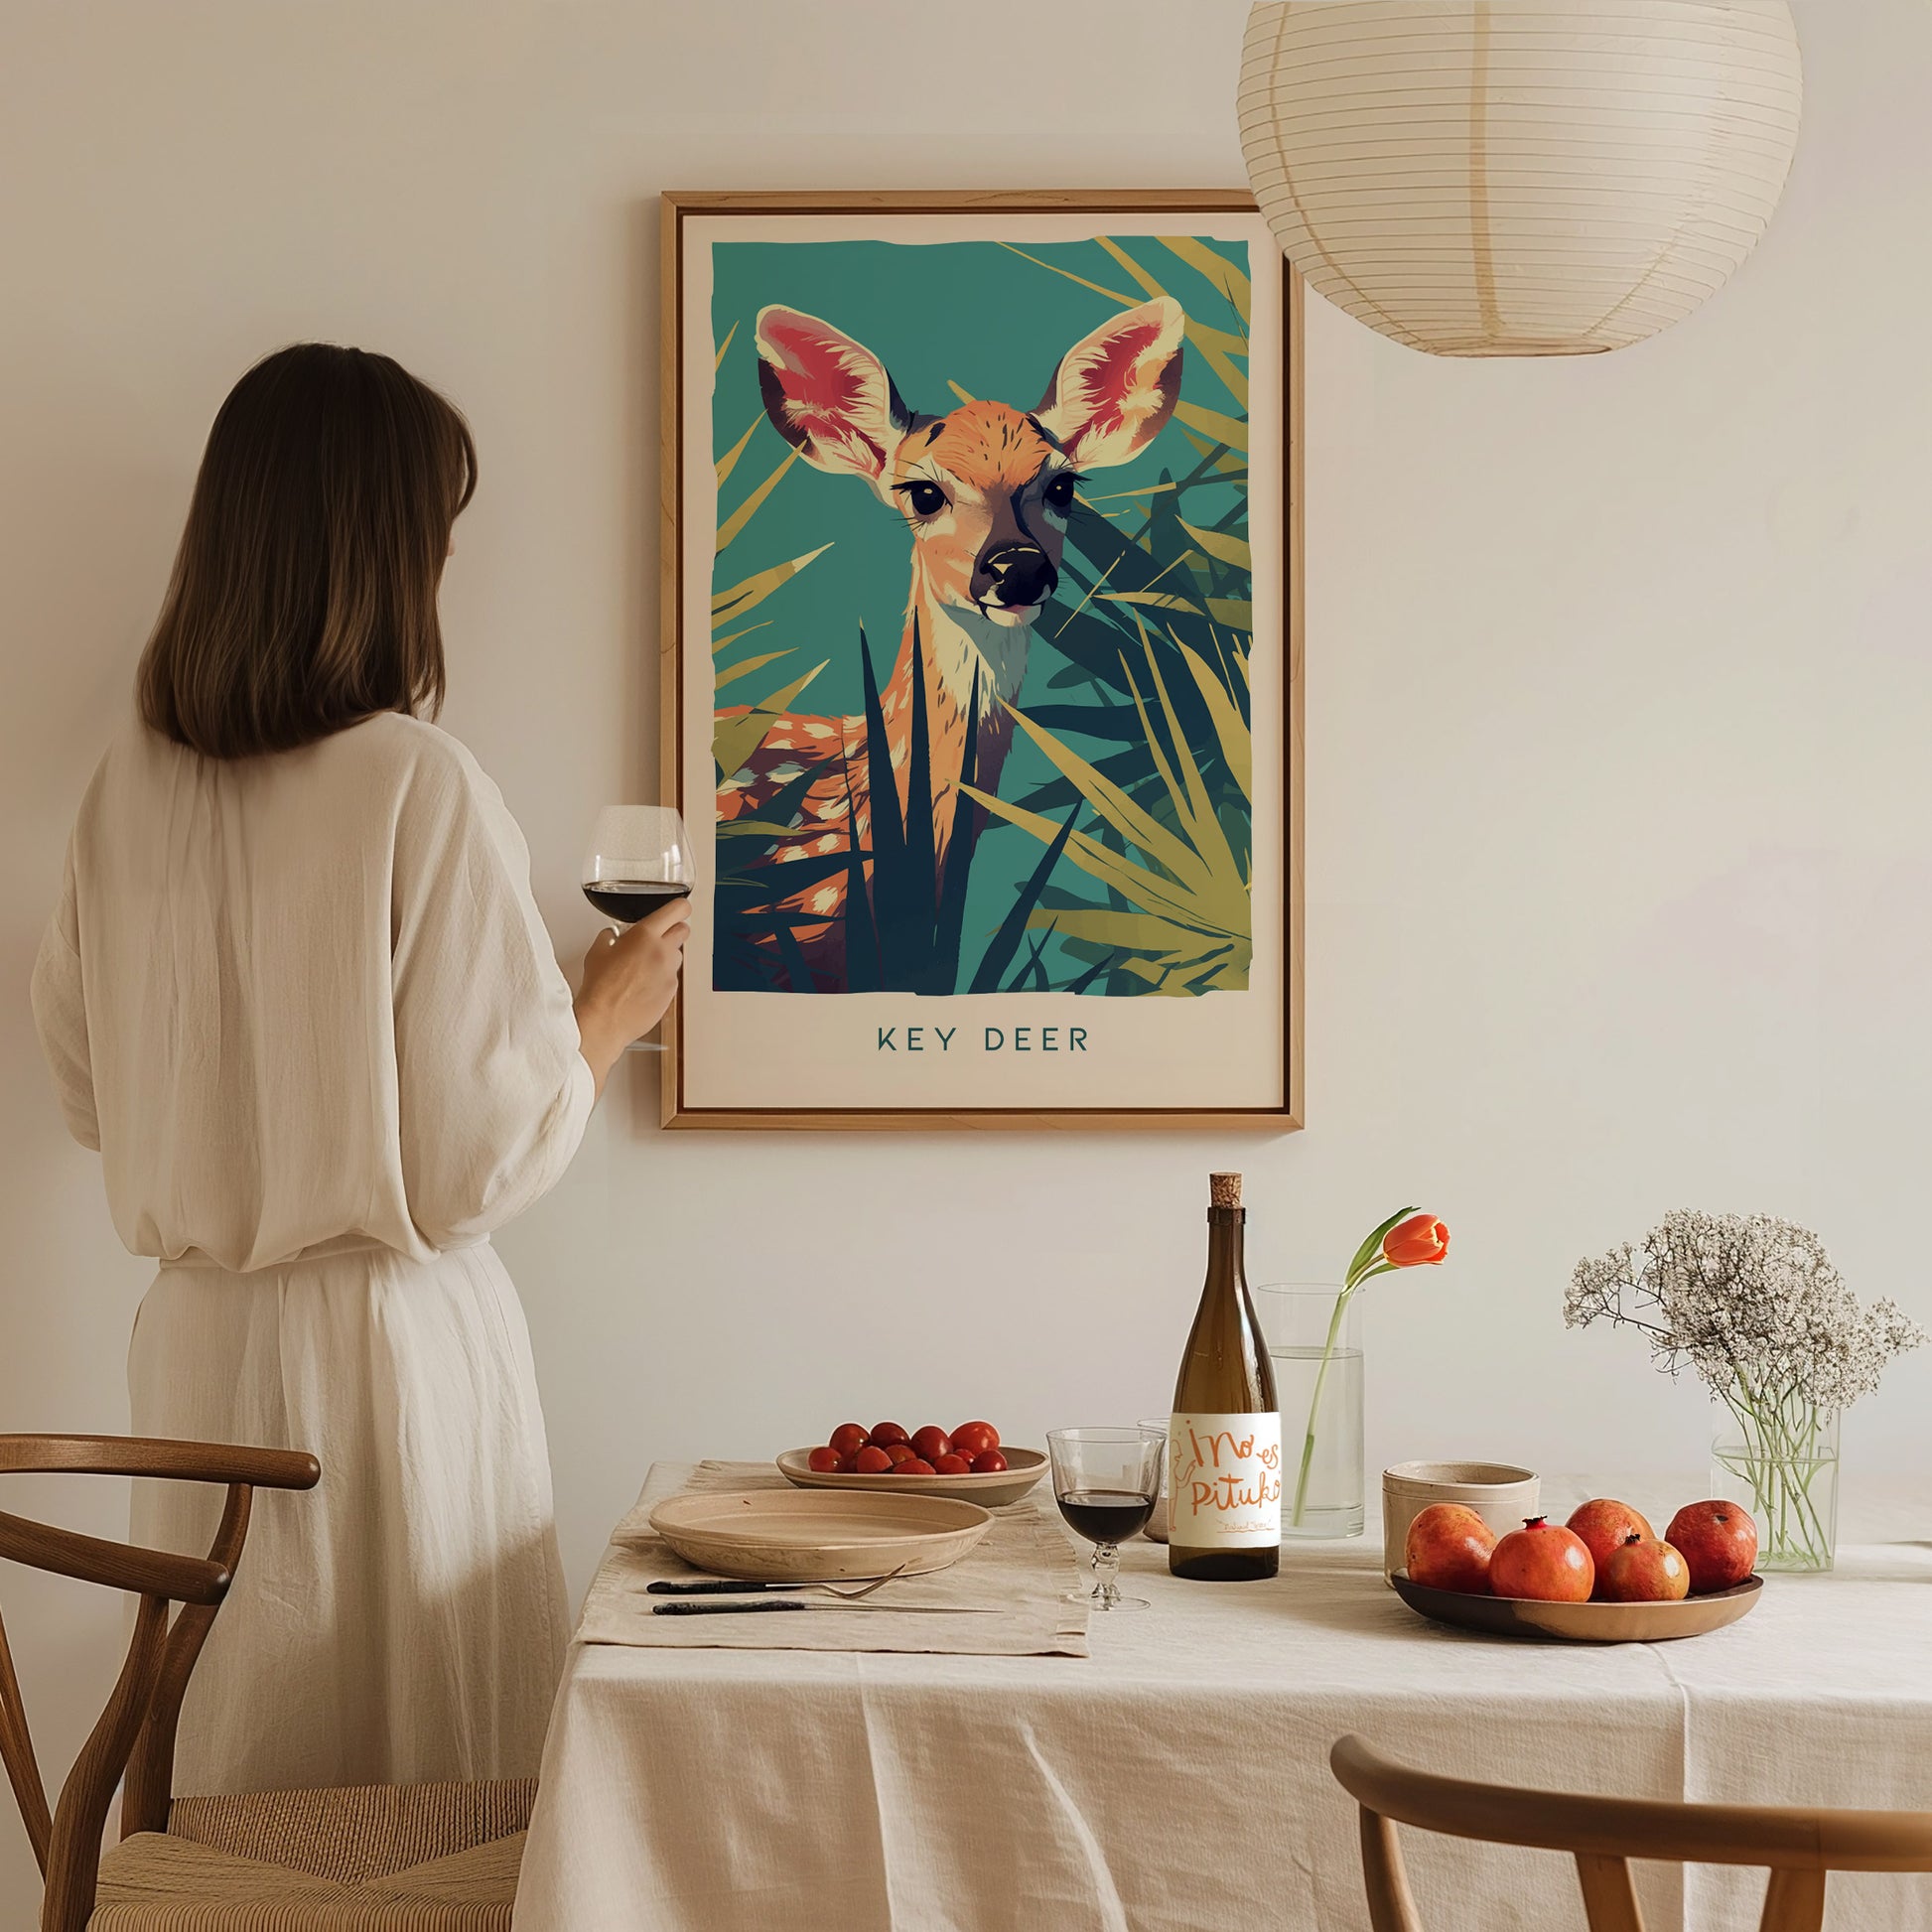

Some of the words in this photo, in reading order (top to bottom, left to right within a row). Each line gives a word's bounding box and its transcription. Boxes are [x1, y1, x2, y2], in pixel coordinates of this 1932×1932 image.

[878, 1027, 957, 1051] KEY
[984, 1027, 1088, 1051] DEER
[1256, 1445, 1279, 1469] es
